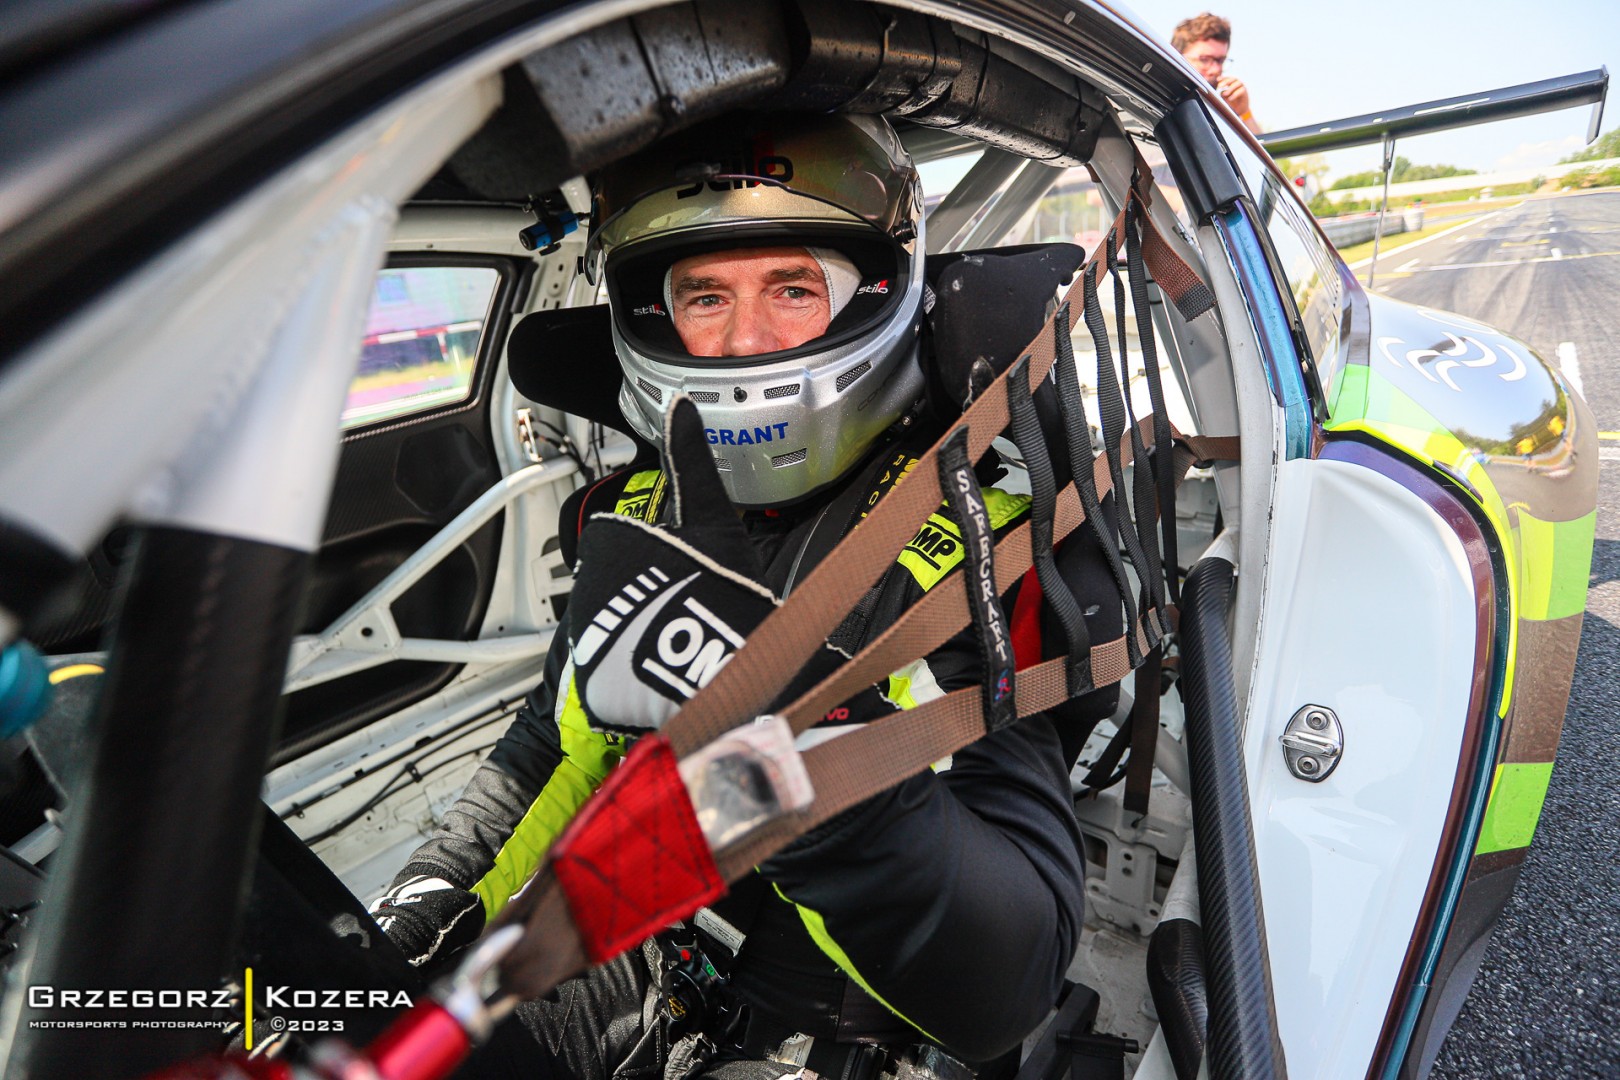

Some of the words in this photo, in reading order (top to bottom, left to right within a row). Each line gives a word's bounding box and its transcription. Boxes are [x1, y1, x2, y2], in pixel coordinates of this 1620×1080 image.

[856, 280, 889, 295] stilo
[633, 304, 666, 316] stilo
[703, 422, 789, 446] GRANT
[911, 526, 957, 559] MP
[956, 469, 1007, 662] SAFECRAFT
[656, 616, 736, 690] OM
[819, 707, 849, 721] VO
